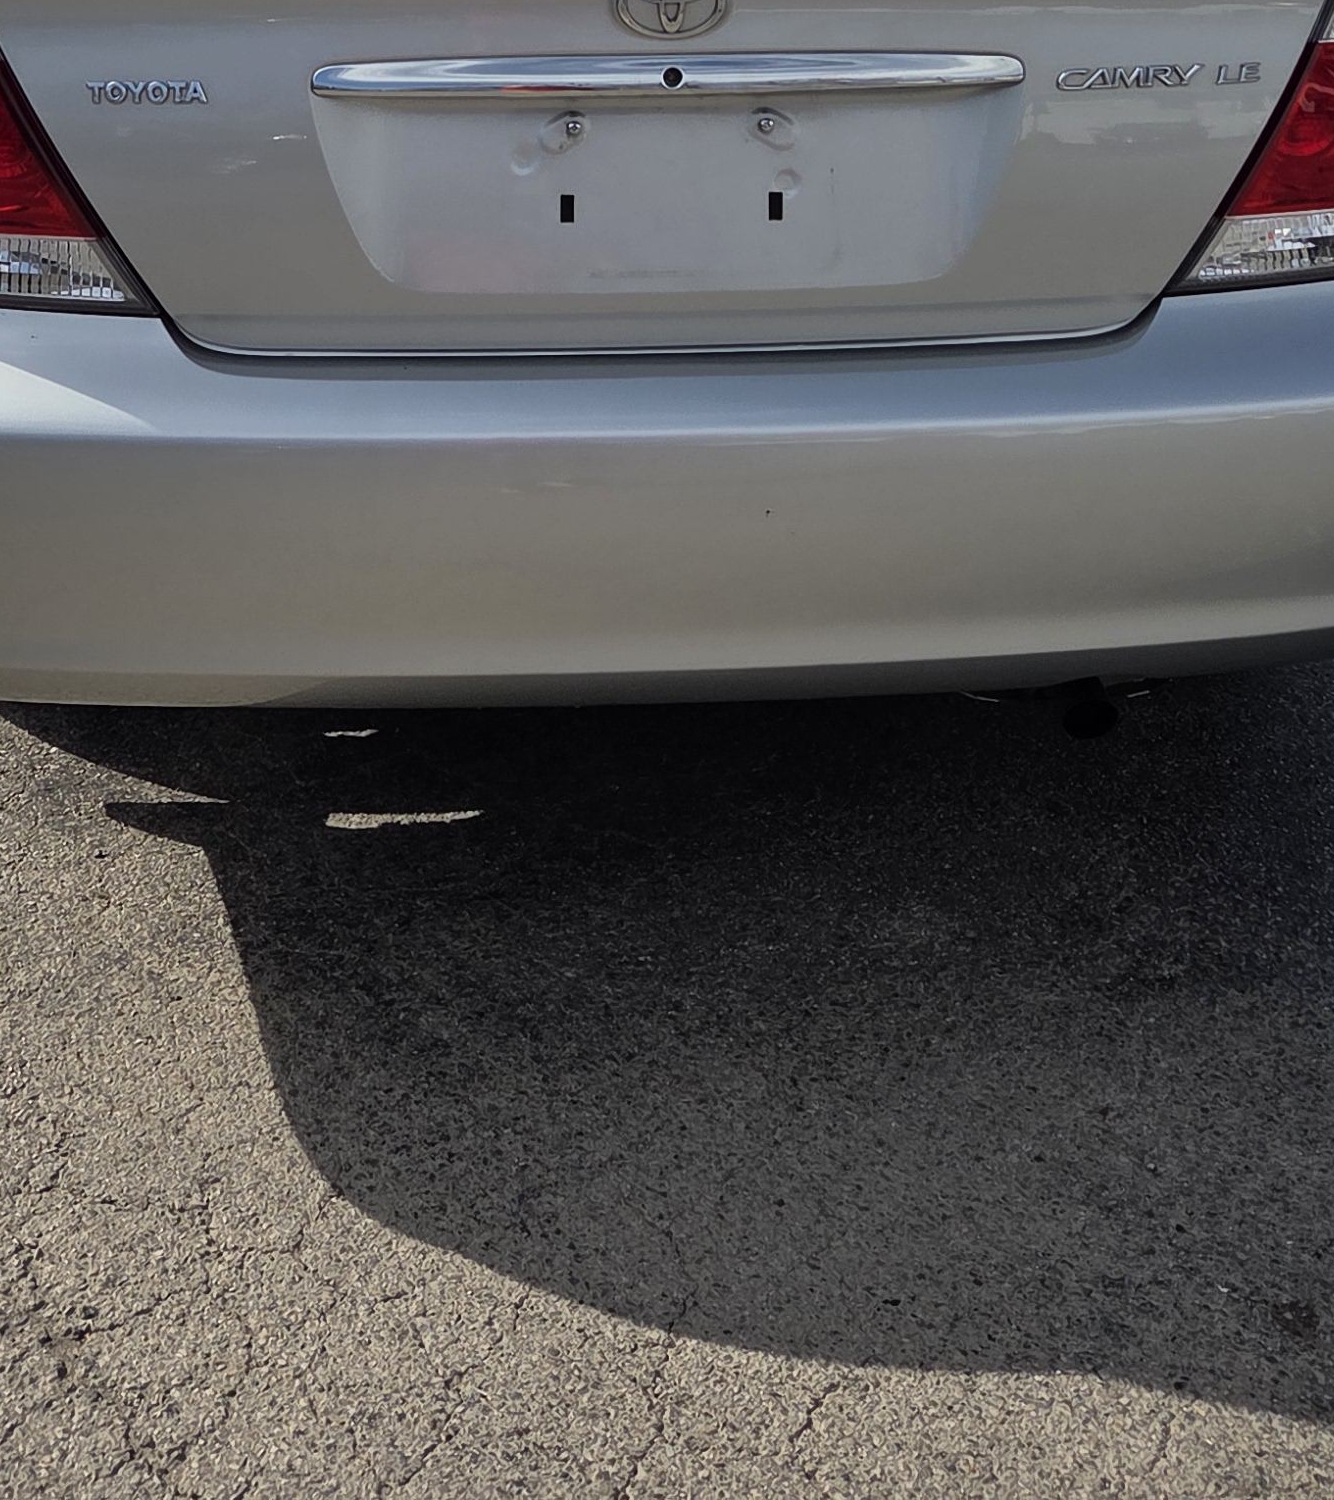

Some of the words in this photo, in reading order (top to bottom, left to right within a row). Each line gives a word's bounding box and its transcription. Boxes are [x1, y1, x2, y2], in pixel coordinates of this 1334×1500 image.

[1057, 63, 1205, 91] CAMRY
[1215, 62, 1262, 85] LE
[86, 80, 209, 105] TOYOTA
